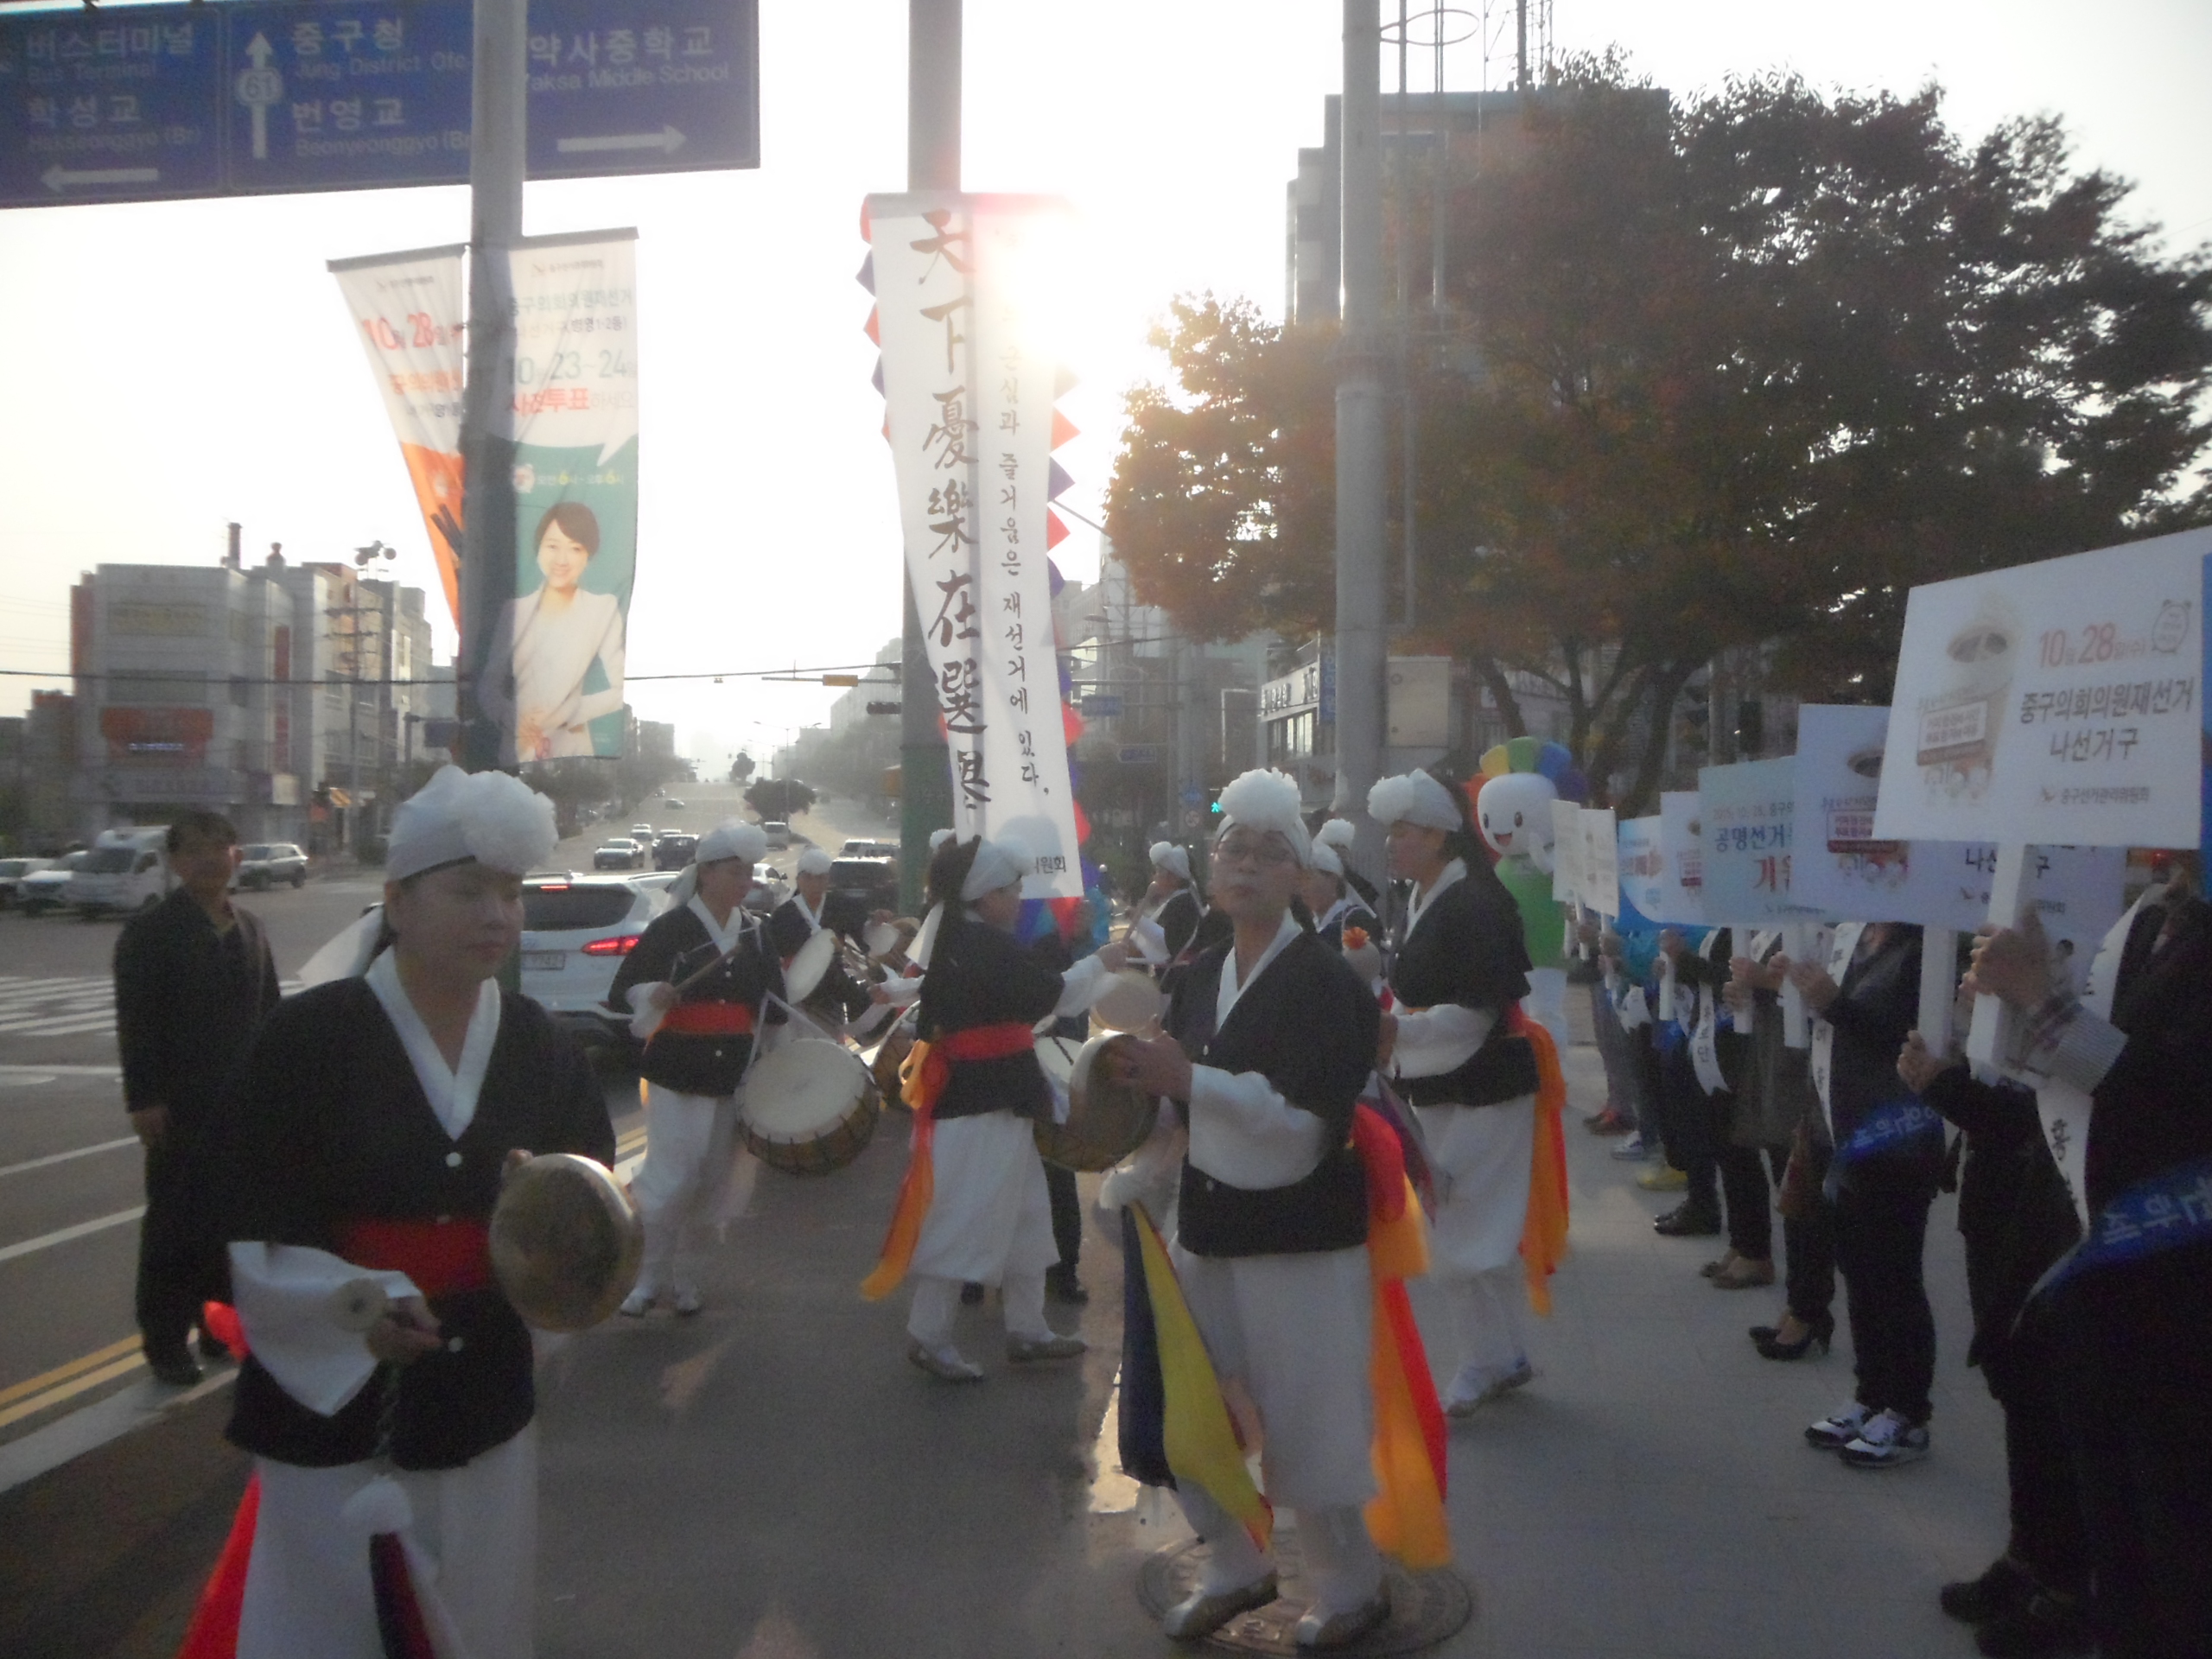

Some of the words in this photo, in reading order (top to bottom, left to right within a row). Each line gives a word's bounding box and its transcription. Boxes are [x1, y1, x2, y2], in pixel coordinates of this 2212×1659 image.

[26, 22, 194, 61] 버스터미널
[291, 17, 404, 55] 중구청
[529, 26, 714, 67] 약사중학교
[526, 73, 582, 92] aksa
[588, 67, 654, 87] Middle
[659, 61, 730, 85] School
[292, 95, 405, 133] 번영교
[1002, 592, 1028, 715] 재선거에
[2020, 676, 2195, 724] 중구의회의원재선거
[2050, 727, 2139, 763] 나선거구
[1714, 823, 1793, 853] 공명선거
